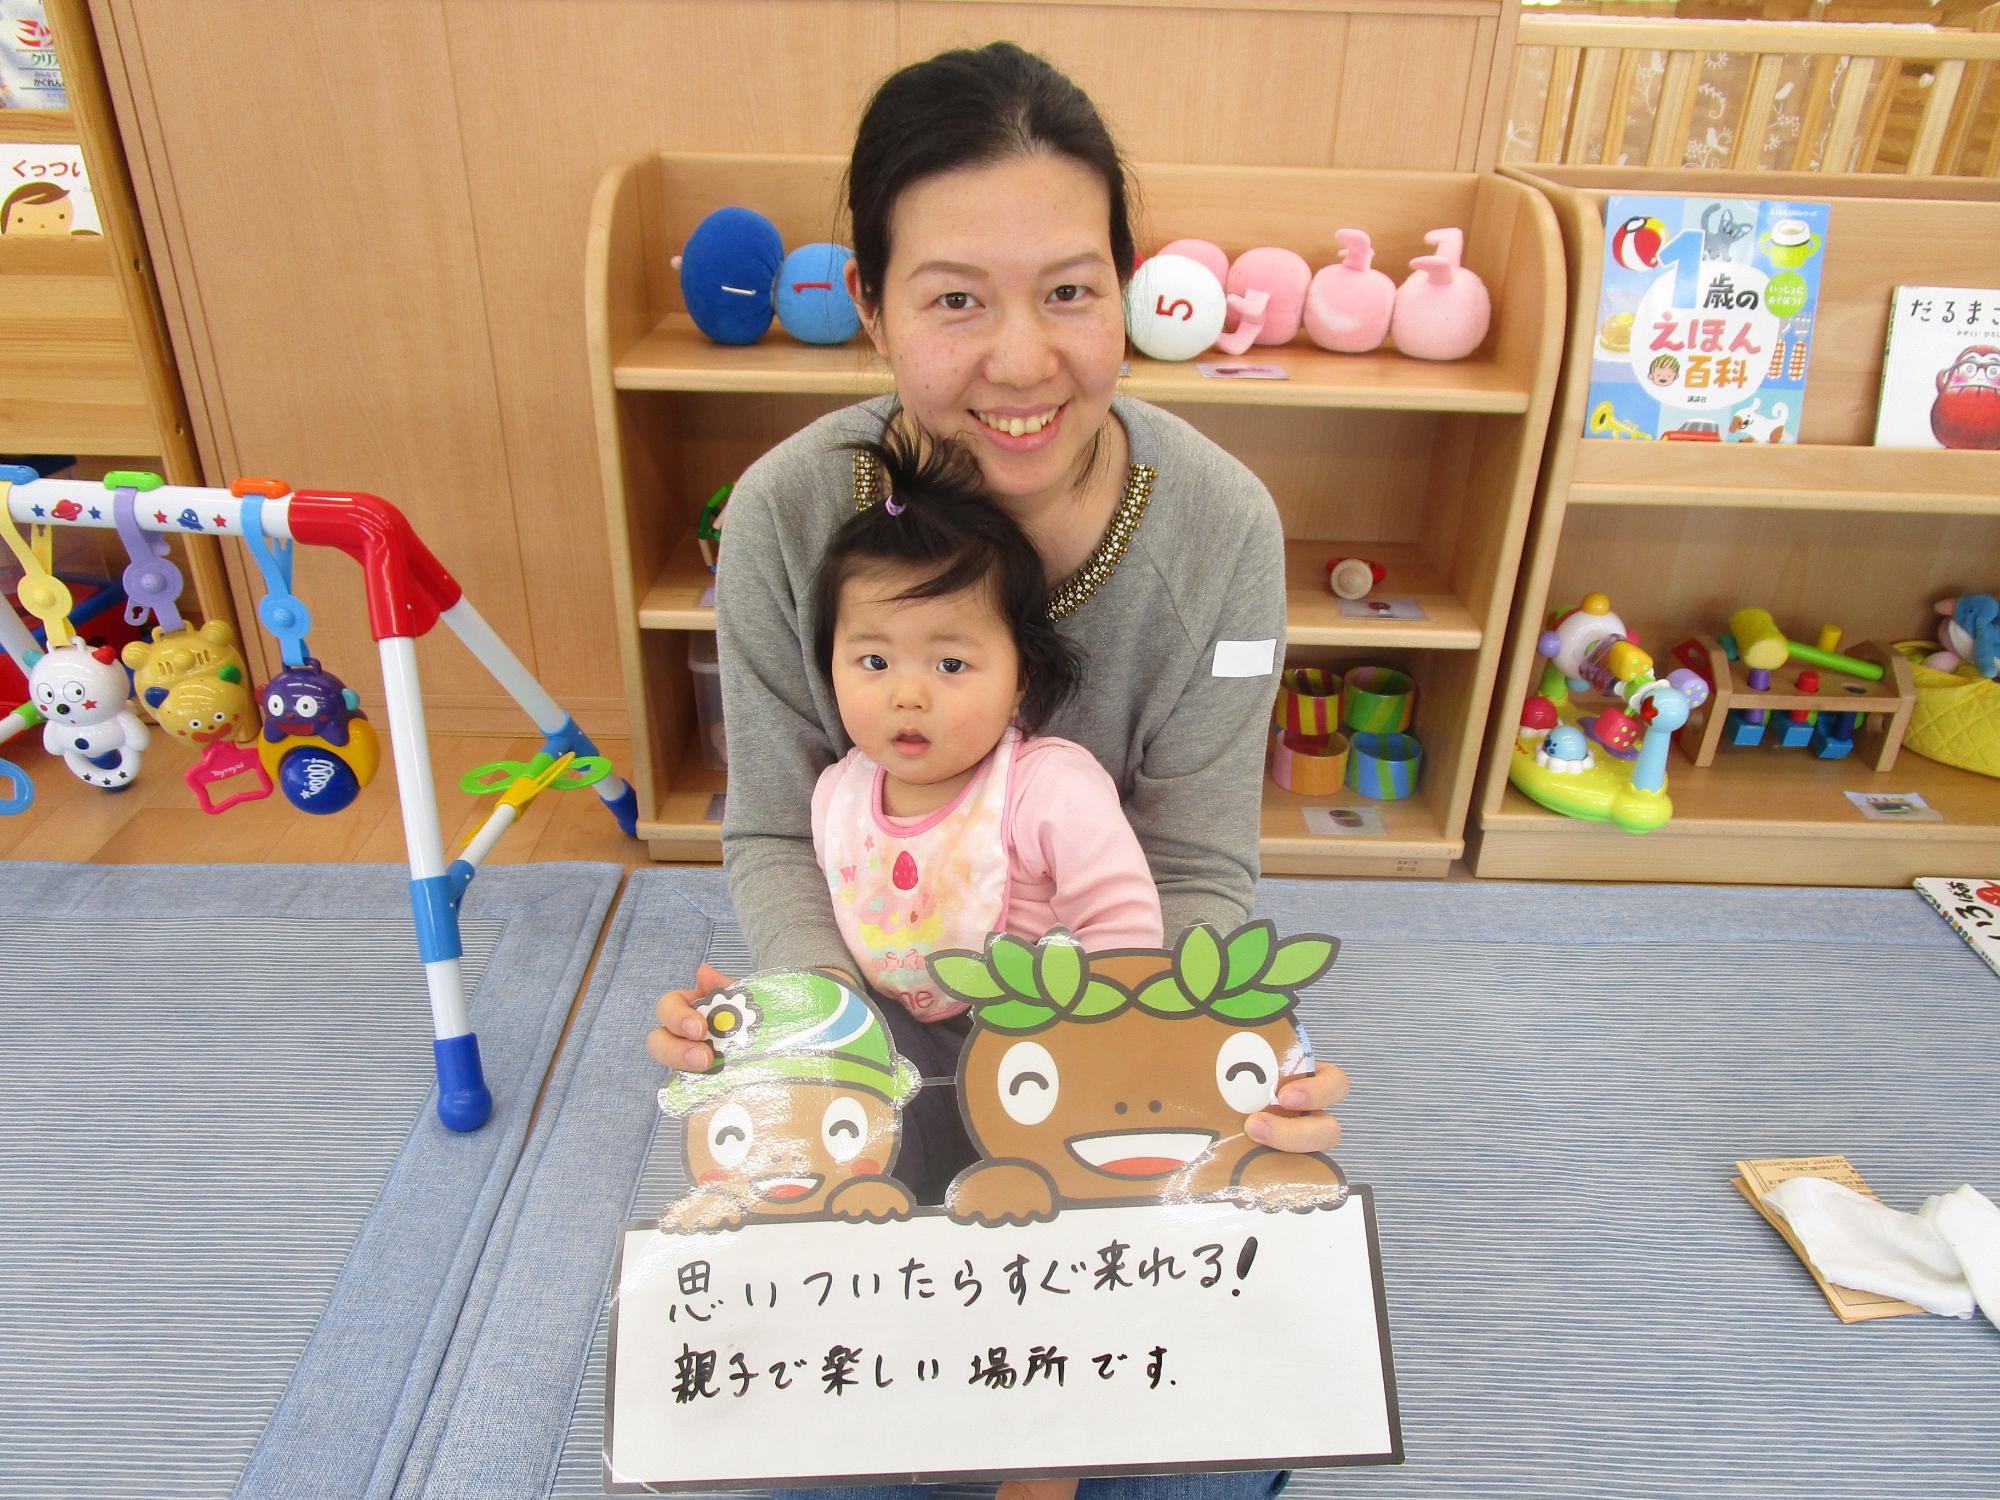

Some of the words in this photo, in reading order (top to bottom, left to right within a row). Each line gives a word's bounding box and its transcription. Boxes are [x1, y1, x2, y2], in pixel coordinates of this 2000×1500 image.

[33, 79, 65, 87] かくれん
[1155, 294, 1194, 322] 5
[1649, 312, 1762, 354] えほん
[1684, 355, 1748, 389] 百科
